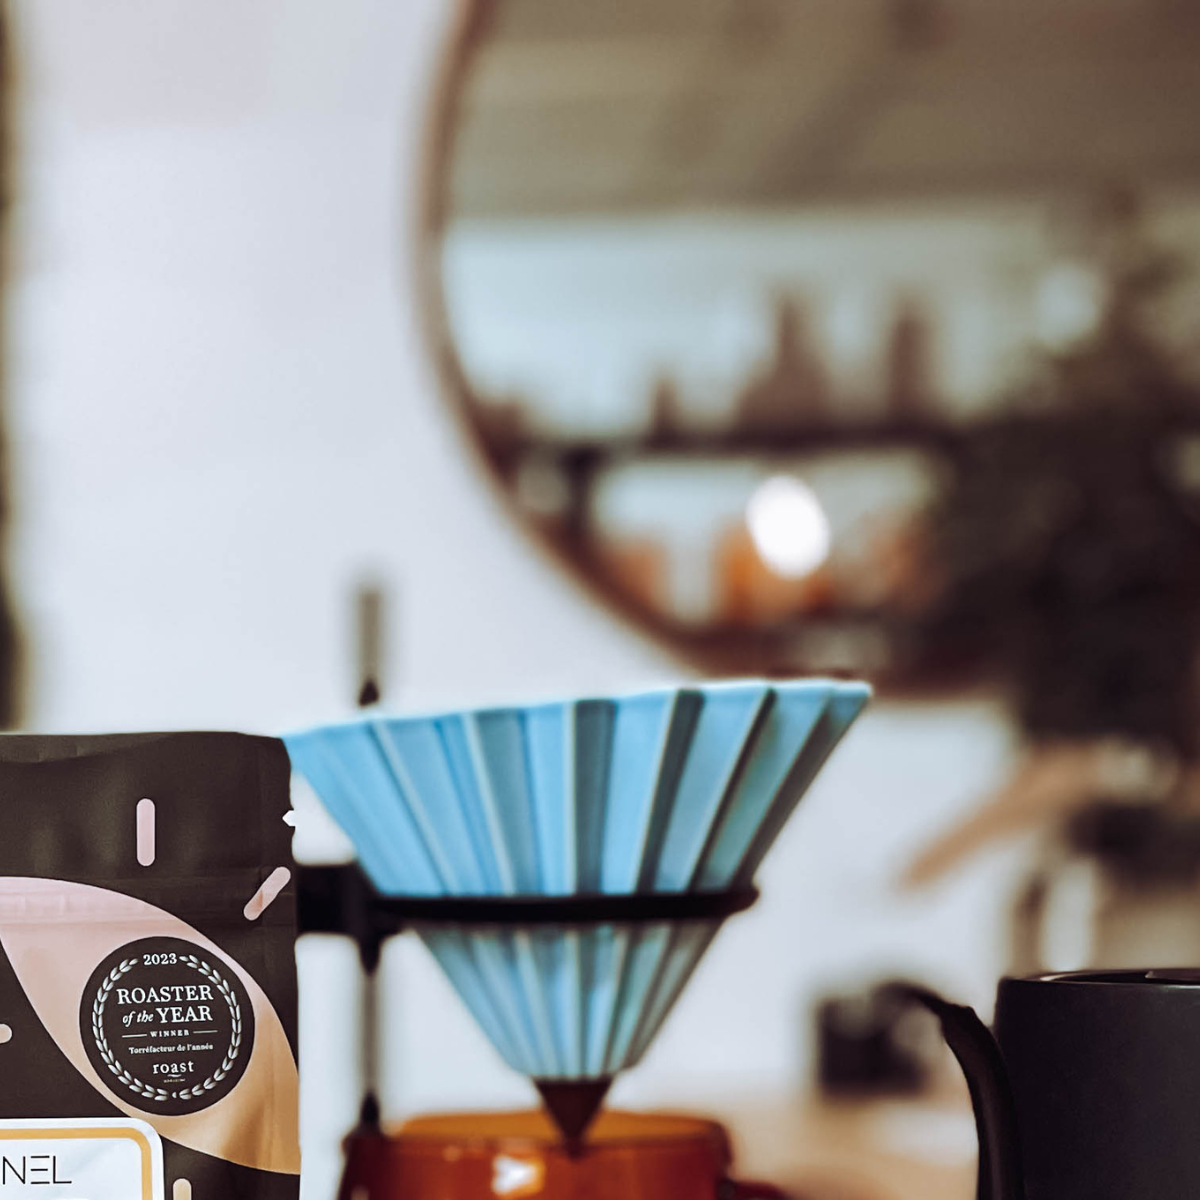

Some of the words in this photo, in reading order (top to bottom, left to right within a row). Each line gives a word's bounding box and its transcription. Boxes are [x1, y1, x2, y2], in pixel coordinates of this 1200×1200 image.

[143, 953, 177, 966] 2023
[116, 984, 214, 1005] ROASTER
[122, 1012, 136, 1027] of
[137, 1010, 154, 1023] the
[156, 1005, 213, 1024] YEAR
[150, 1029, 190, 1038] WINNER
[128, 1045, 176, 1055] Torréfacteur
[177, 1044, 186, 1052] de
[152, 1060, 194, 1075] roast
